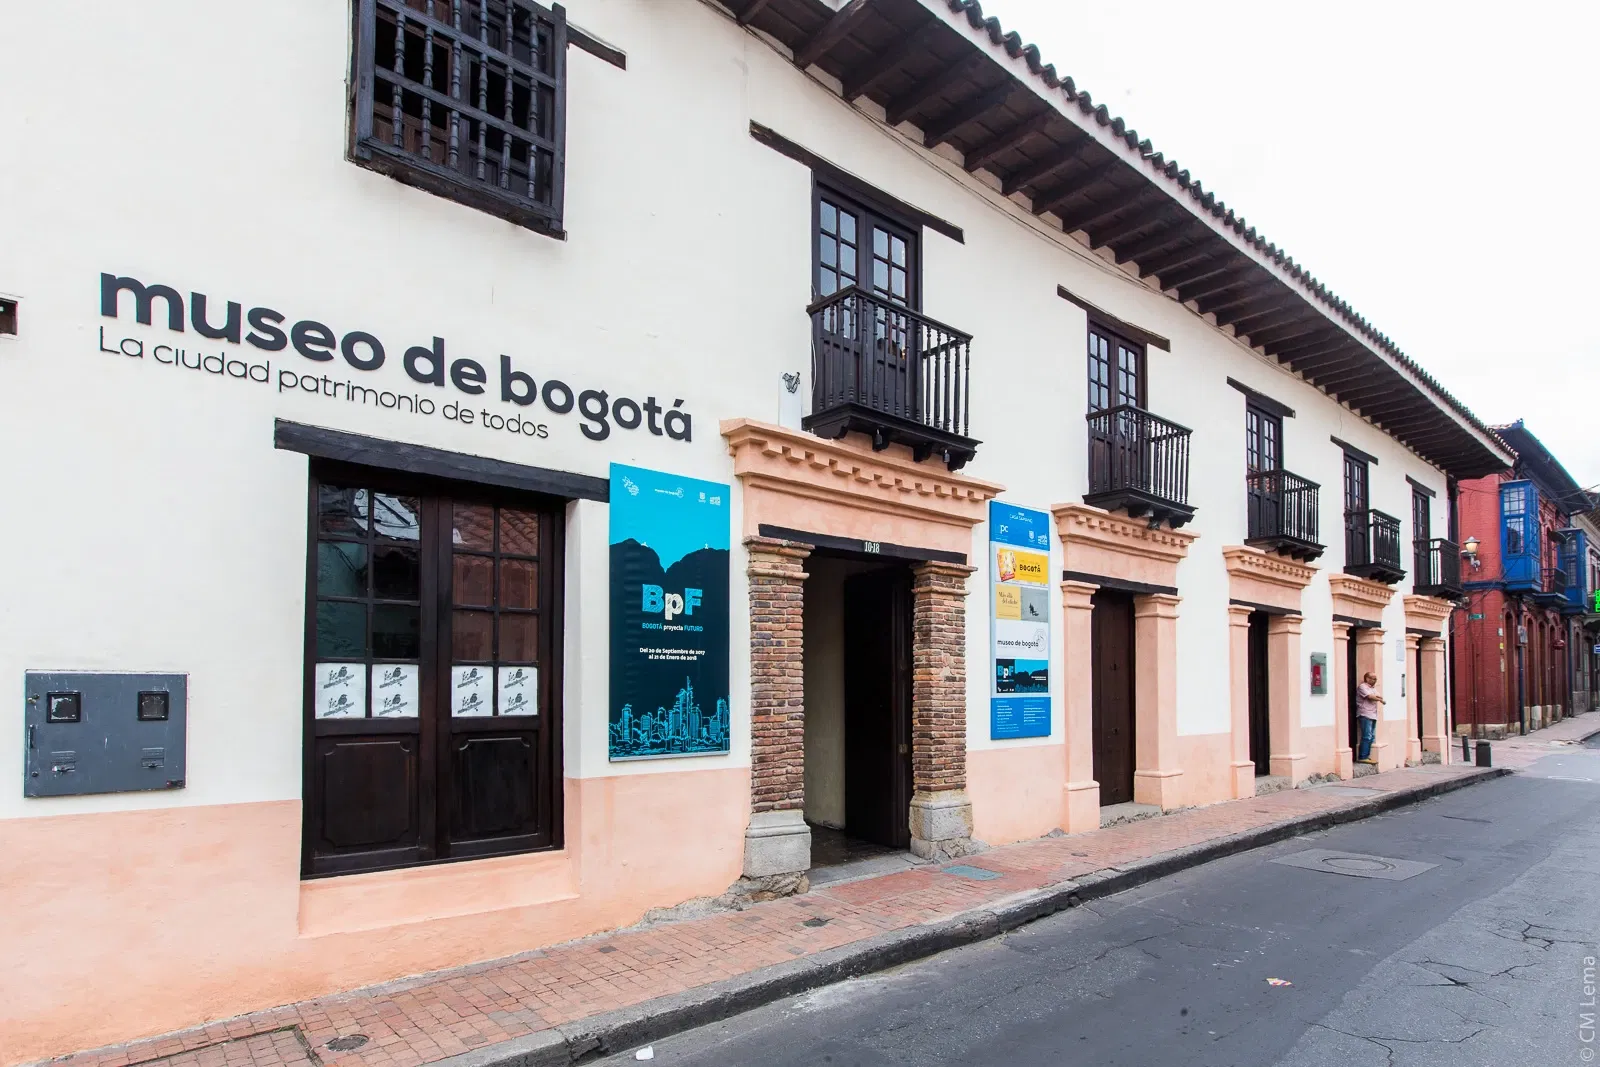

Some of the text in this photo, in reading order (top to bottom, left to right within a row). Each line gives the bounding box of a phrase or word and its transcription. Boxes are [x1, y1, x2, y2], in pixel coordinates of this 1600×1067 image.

[100, 272, 692, 442] museo de bogotá
[99, 325, 549, 439] La ciudad patrimonio de todos
[864, 541, 880, 553] 10-18
[1019, 564, 1041, 572] BOGOTÁ
[642, 583, 703, 621] BpF
[642, 622, 663, 630] BOGOTÁ
[663, 624, 683, 632] proyecta
[997, 666, 1014, 679] BpF
